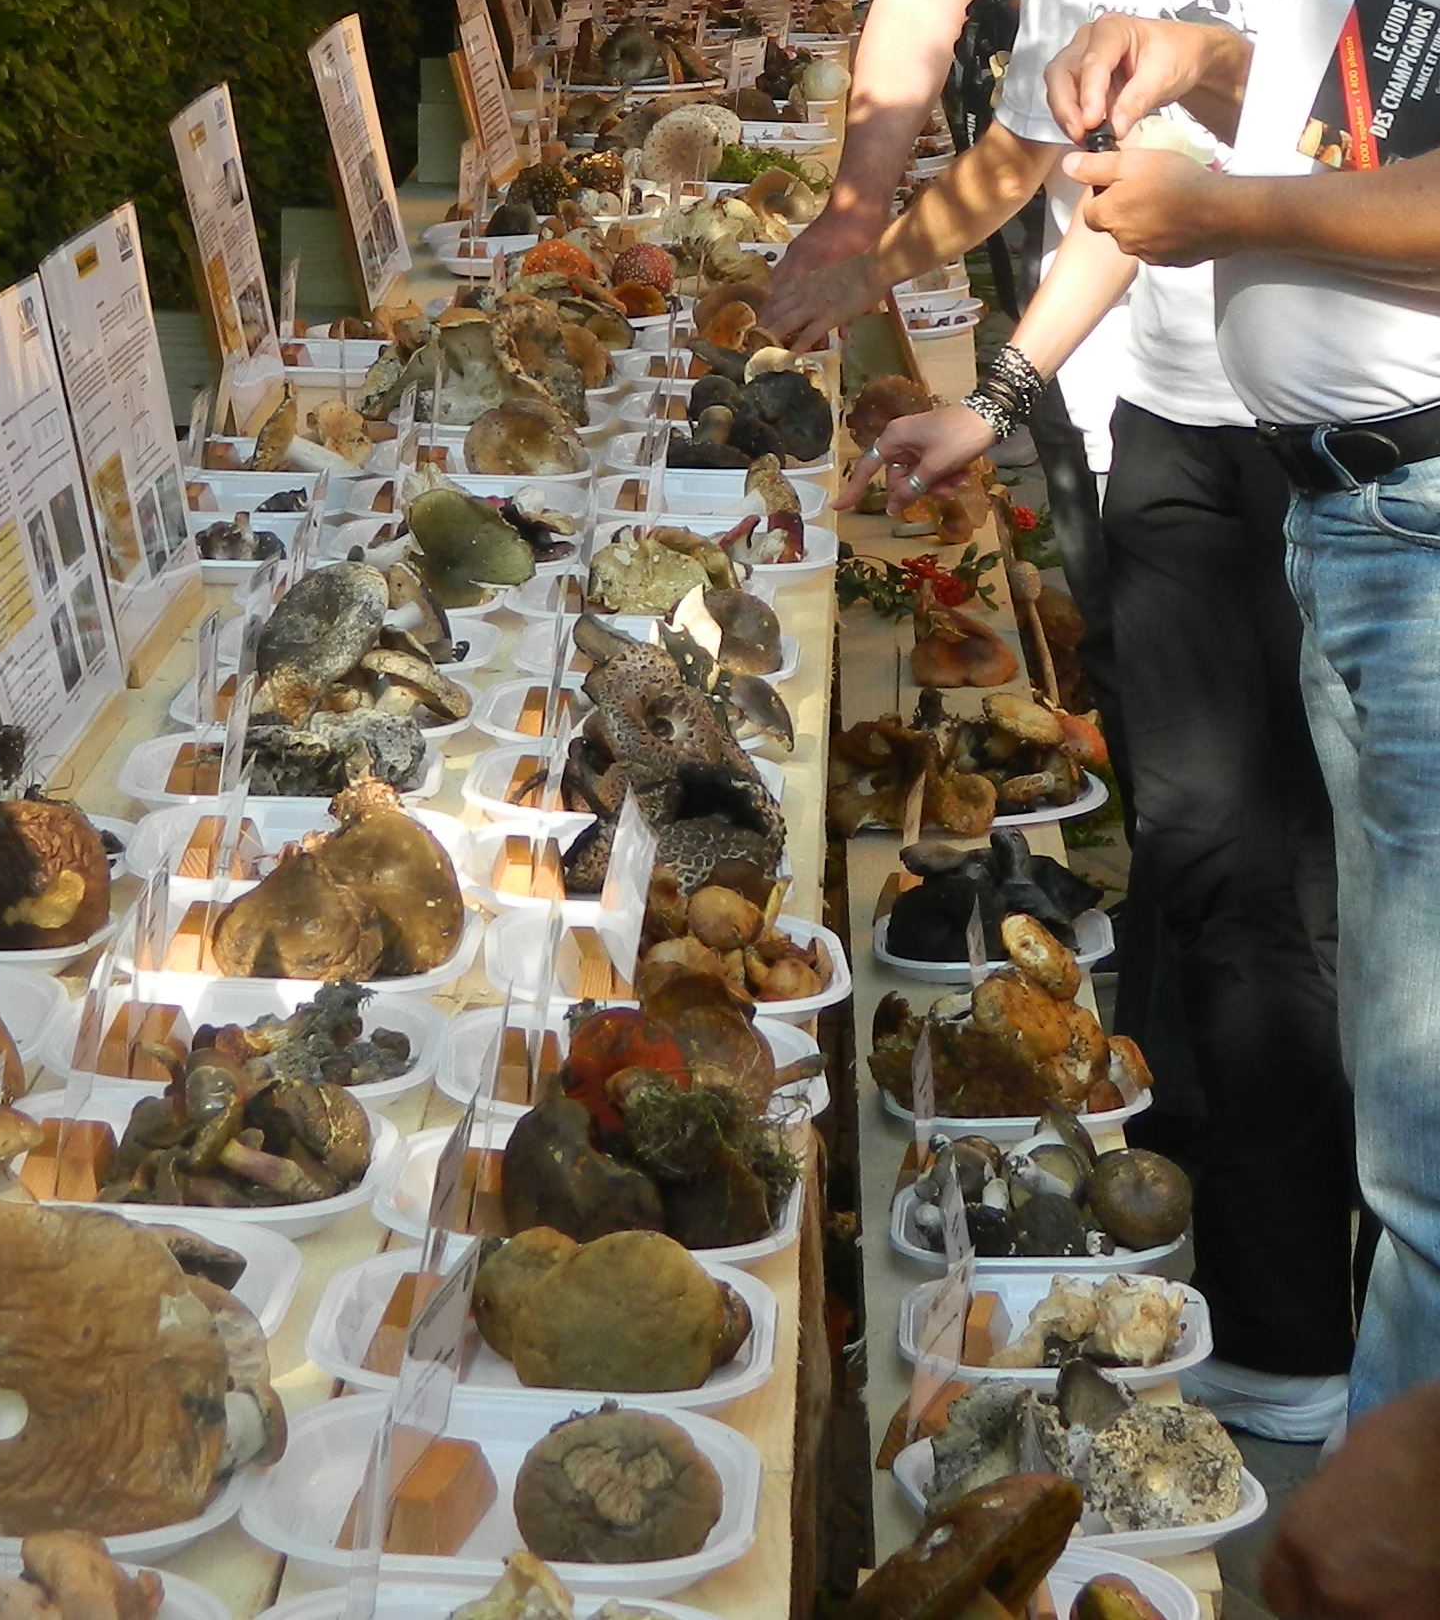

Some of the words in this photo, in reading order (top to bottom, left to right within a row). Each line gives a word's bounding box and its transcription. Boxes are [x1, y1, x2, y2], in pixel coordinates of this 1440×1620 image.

[1345, 36, 1358, 68] photos
[1372, 42, 1395, 62] LE
[1381, 7, 1436, 110] CHAMPIGNONS
[1410, 63, 1435, 101] FRANCE
[1425, 51, 1439, 66] ET
[1368, 108, 1395, 139] DES
